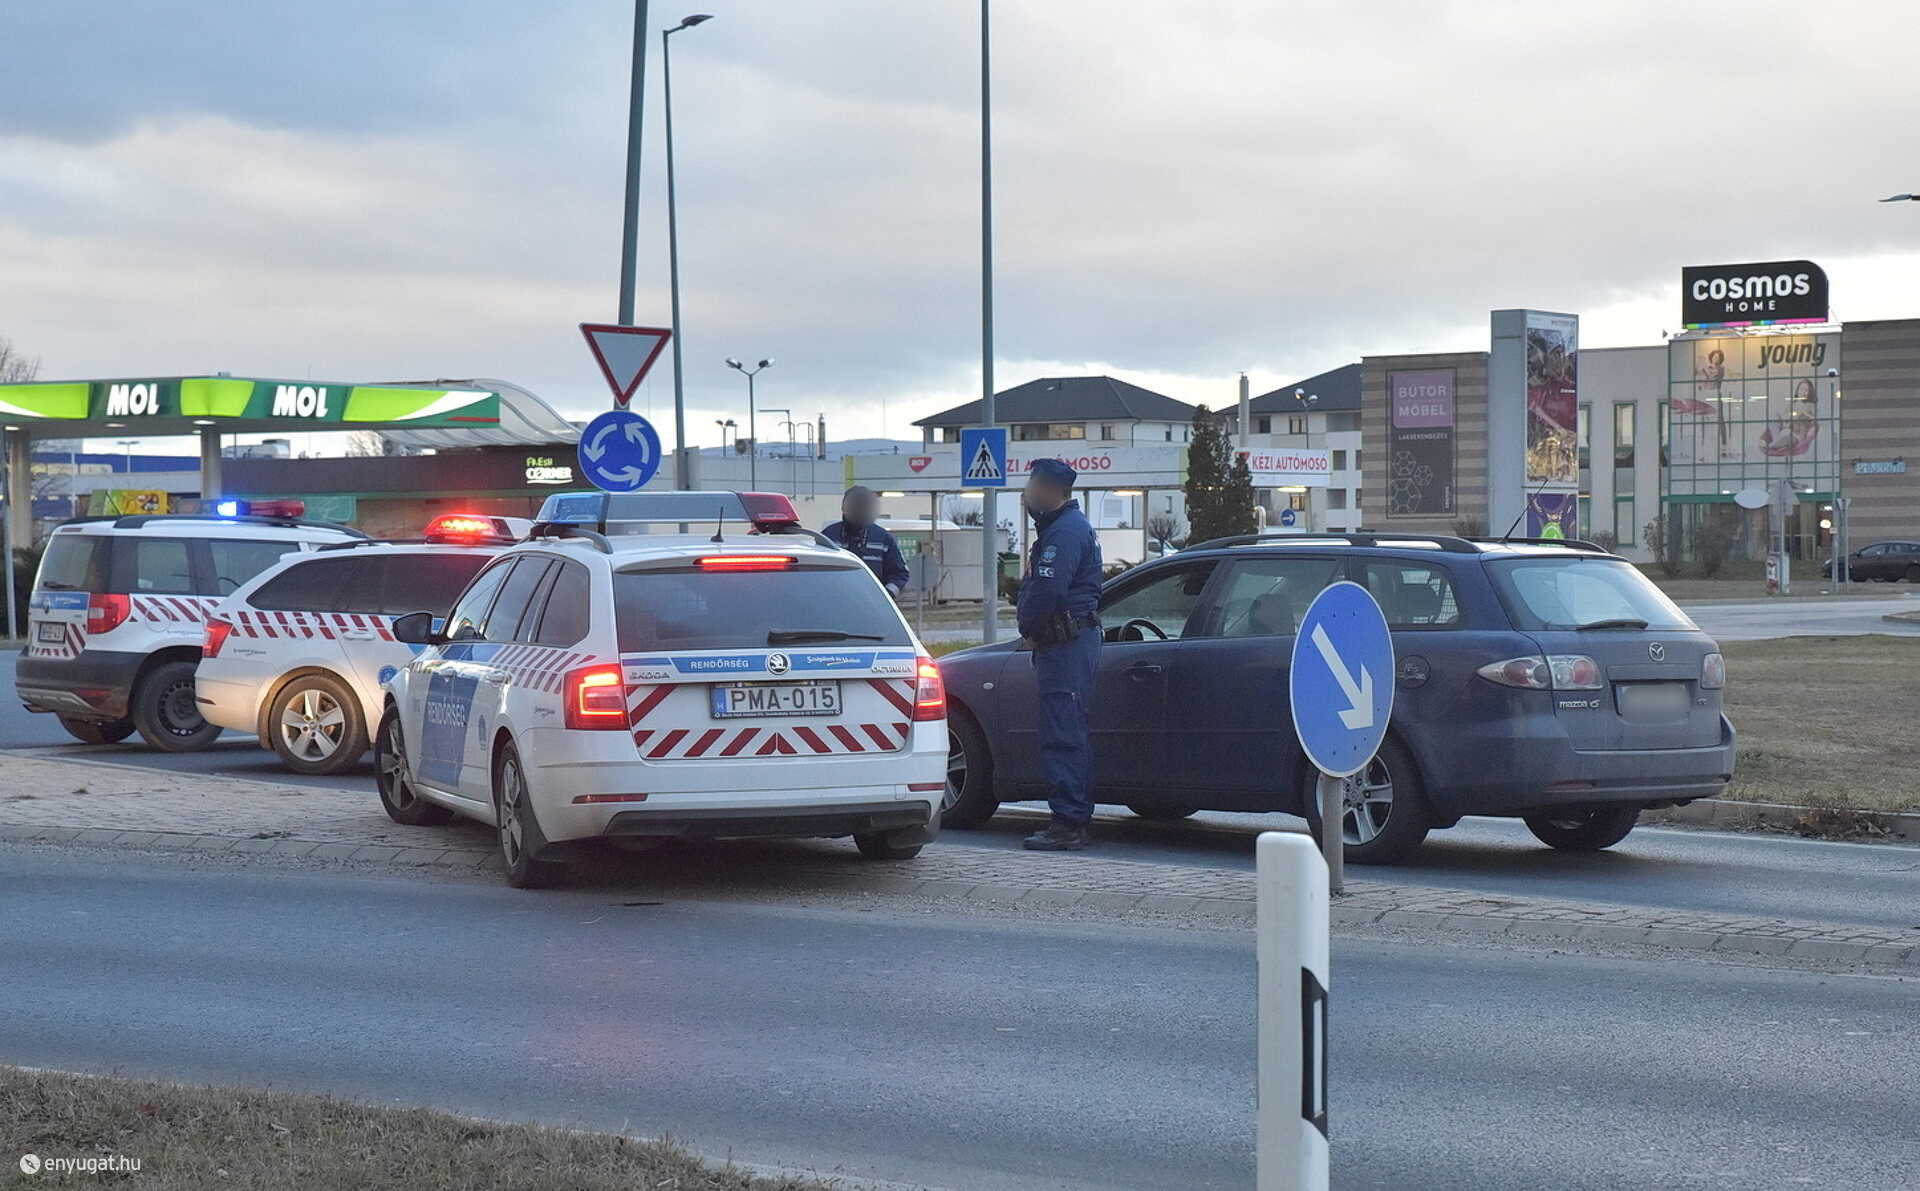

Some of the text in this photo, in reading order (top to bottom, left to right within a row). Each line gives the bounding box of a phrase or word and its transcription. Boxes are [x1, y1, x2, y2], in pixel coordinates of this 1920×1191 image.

[1692, 273, 1811, 301] cosmos
[1725, 300, 1777, 313] HOME
[1757, 342, 1827, 369] young
[106, 383, 160, 416] MOL
[272, 385, 329, 418] MOL
[1252, 452, 1328, 471] KÉZI AUTÓMOSÓ
[730, 687, 834, 711] PMA-015
